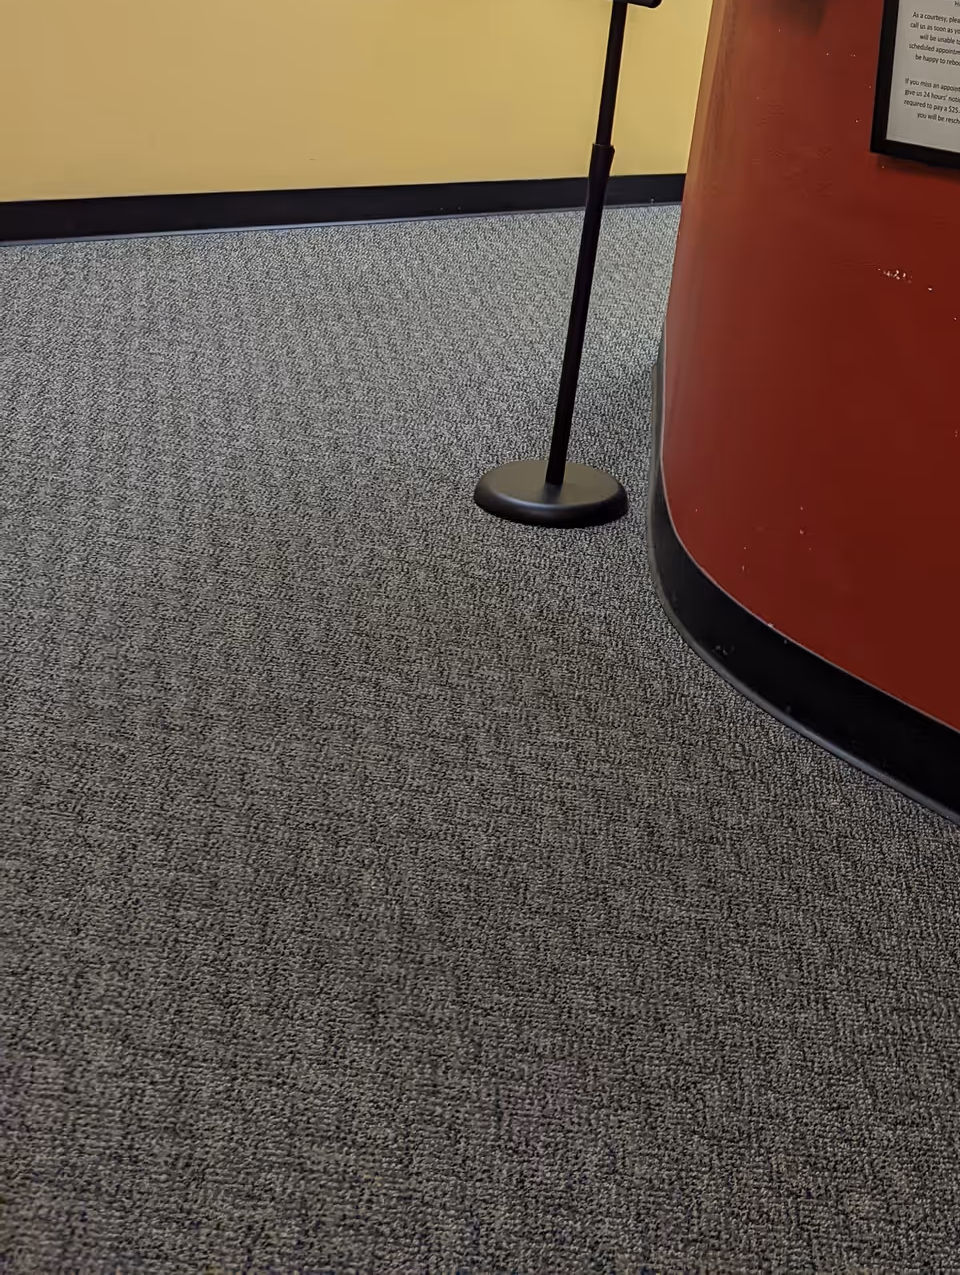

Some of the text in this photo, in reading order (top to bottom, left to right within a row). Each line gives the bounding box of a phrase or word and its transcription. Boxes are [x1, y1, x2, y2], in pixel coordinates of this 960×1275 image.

[924, 14, 948, 23] courtesy,
[909, 43, 934, 52] scheduled
[923, 56, 939, 64] happy
[904, 100, 925, 108] required
